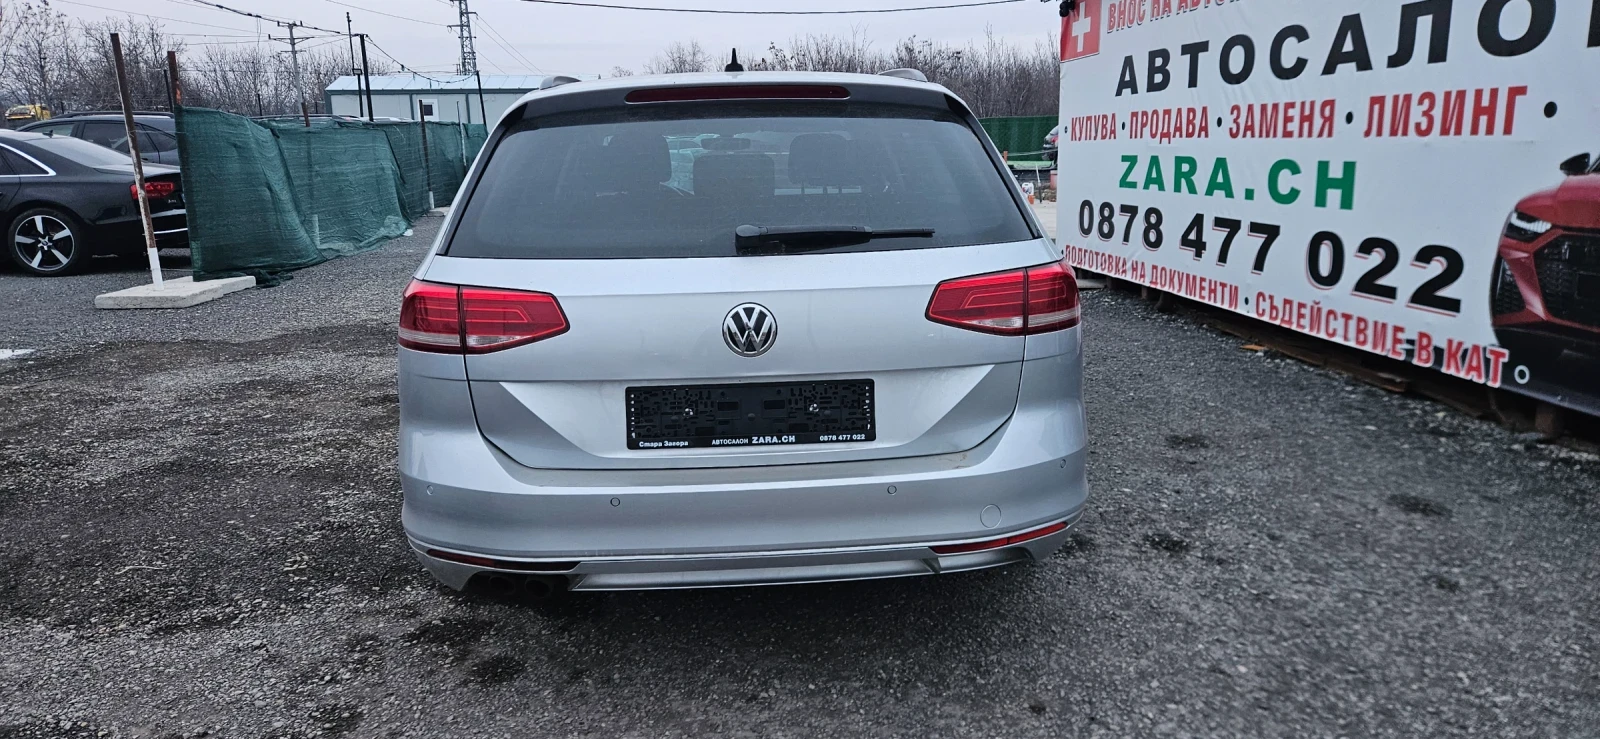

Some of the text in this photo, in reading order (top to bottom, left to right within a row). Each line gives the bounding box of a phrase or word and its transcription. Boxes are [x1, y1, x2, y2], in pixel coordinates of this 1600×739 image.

[1107, 0, 1147, 33] ВНОС
[1115, 0, 1600, 97] АВТОСАЛО
[1070, 85, 1528, 144] КУПУВА ПРОДАВА ЗАМЕНЯ ЛИЗИНГ
[1118, 154, 1357, 211] ZARA.CH
[1078, 199, 1465, 318] 0878 477 022
[1065, 244, 1510, 388] ПОДГОТОВКА НА ДОКУМЕНТИ СЪДЕЙСТВИЕ В КАТ
[752, 435, 796, 444] ZARA.CH
